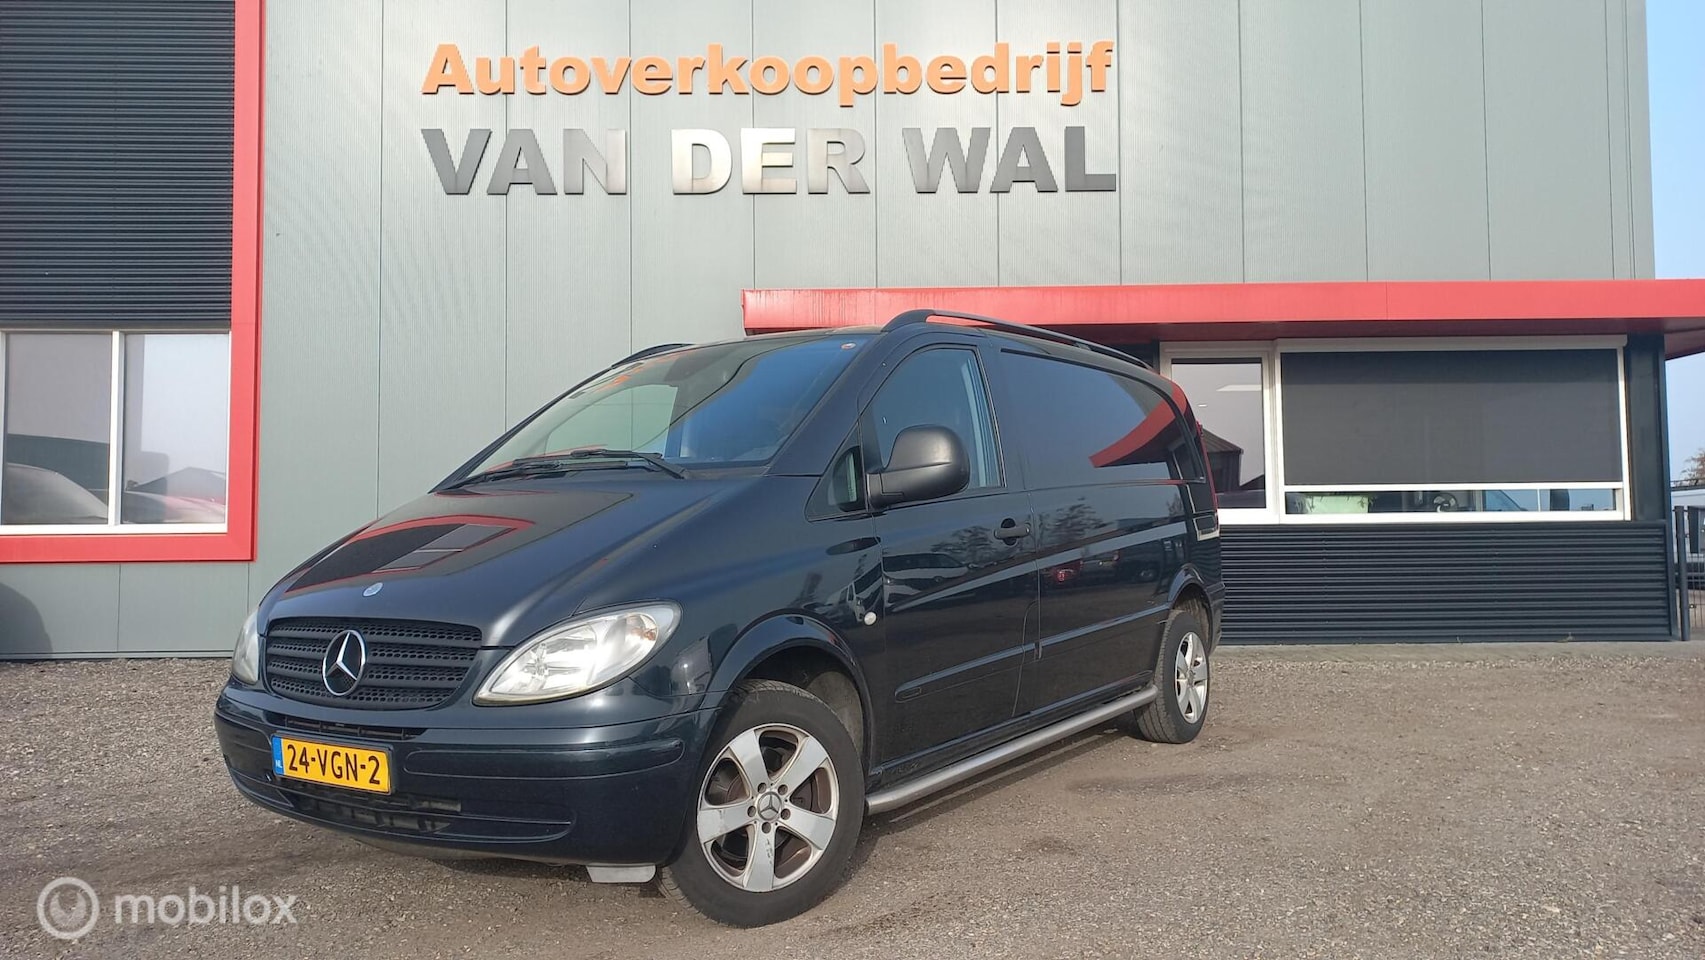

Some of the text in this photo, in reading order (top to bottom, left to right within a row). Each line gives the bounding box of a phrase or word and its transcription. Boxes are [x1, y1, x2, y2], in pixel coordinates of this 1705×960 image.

[421, 41, 1115, 107] Autoverkoopbedrijf
[421, 126, 1117, 195] VAN DER WAL
[287, 744, 380, 785] 24-VGN-2
